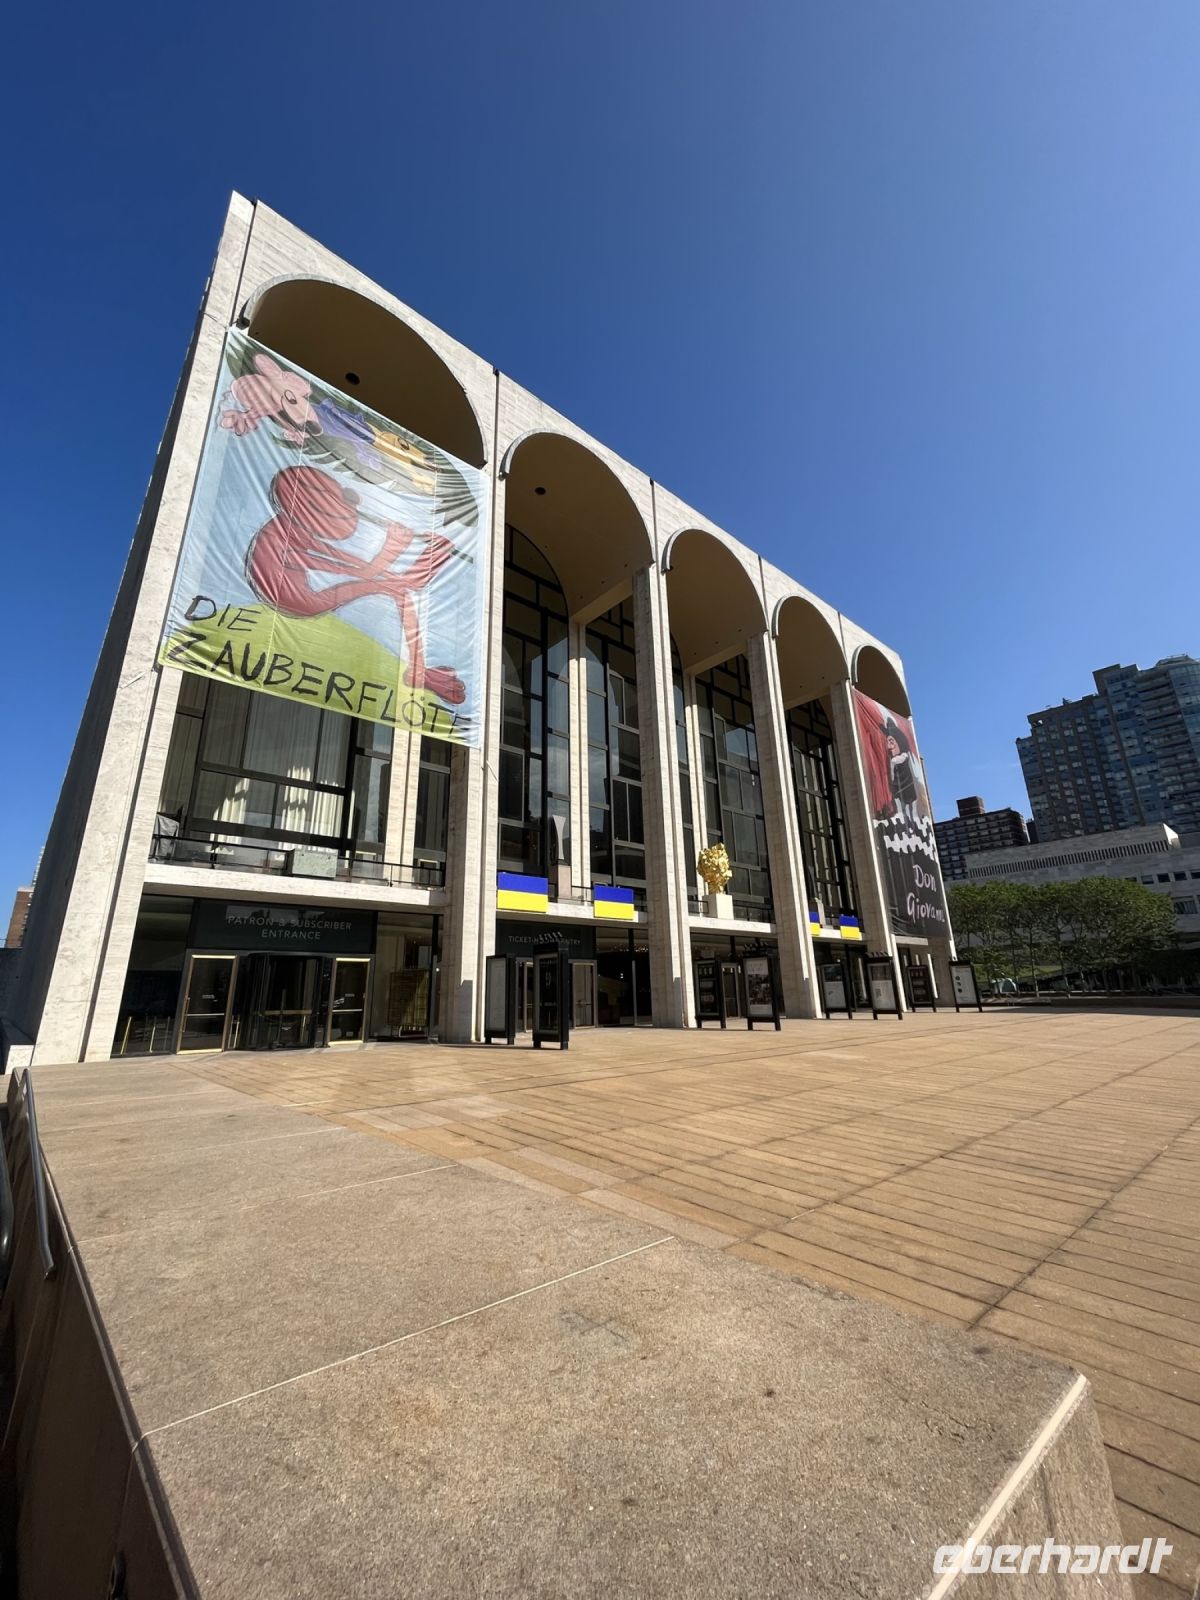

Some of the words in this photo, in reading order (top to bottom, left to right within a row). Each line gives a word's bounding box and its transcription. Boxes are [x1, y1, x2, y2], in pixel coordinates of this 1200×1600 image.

[183, 594, 262, 632] DIE
[912, 864, 936, 892] Don
[227, 915, 275, 927] PATRON
[290, 918, 352, 931] SUBSCRIBER
[261, 929, 321, 940] ENTRANCE
